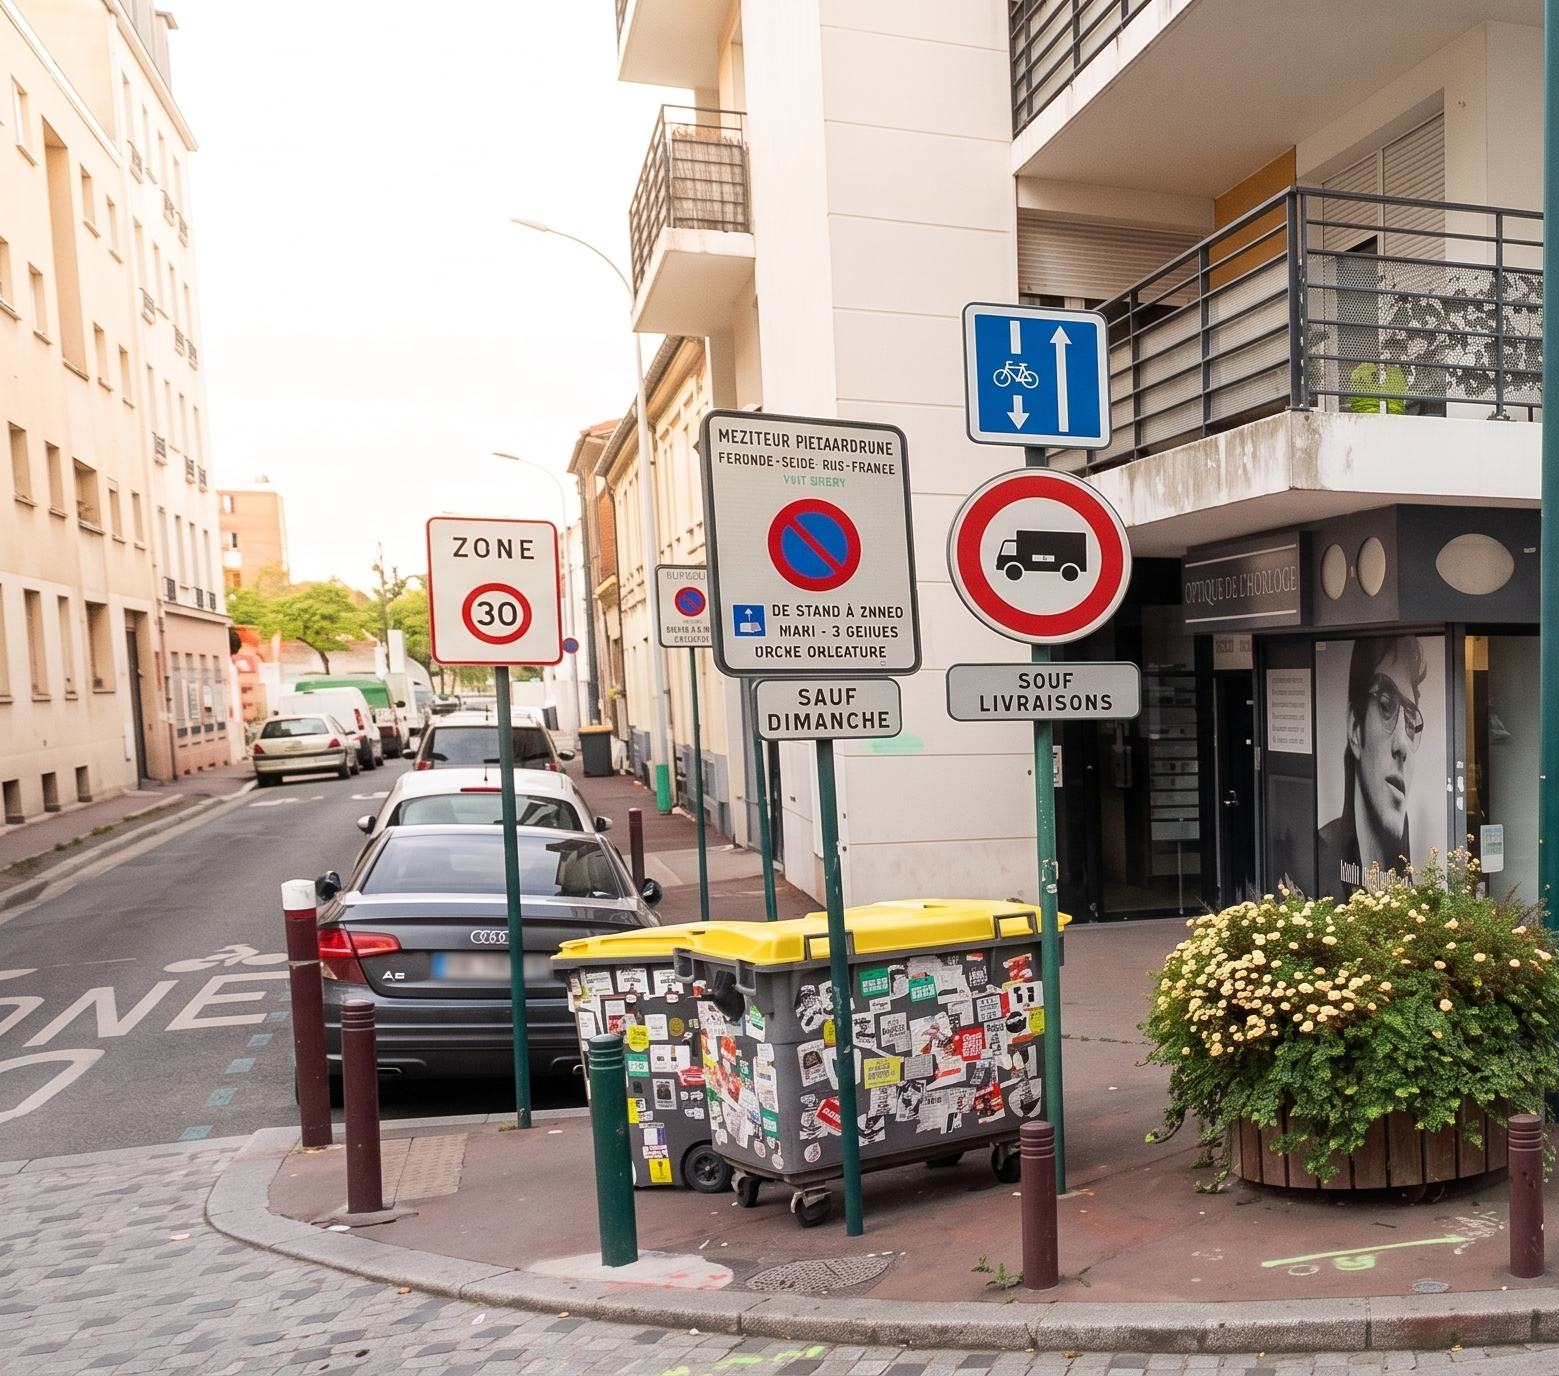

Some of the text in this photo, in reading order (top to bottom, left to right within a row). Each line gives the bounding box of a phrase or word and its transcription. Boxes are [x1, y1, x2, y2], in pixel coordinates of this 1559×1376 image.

[453, 537, 535, 560] ZONE
[1185, 577, 1224, 606] OPTIQUE
[1225, 575, 1238, 599] DE
[476, 601, 518, 627] 30
[772, 604, 790, 617] DE
[796, 604, 841, 618] STAND
[832, 625, 841, 638] 3
[1018, 672, 1074, 690] SOUF
[798, 687, 857, 706] SAUF
[979, 694, 1113, 712] LIVRAISONS
[767, 711, 891, 731] DIMANCHE
